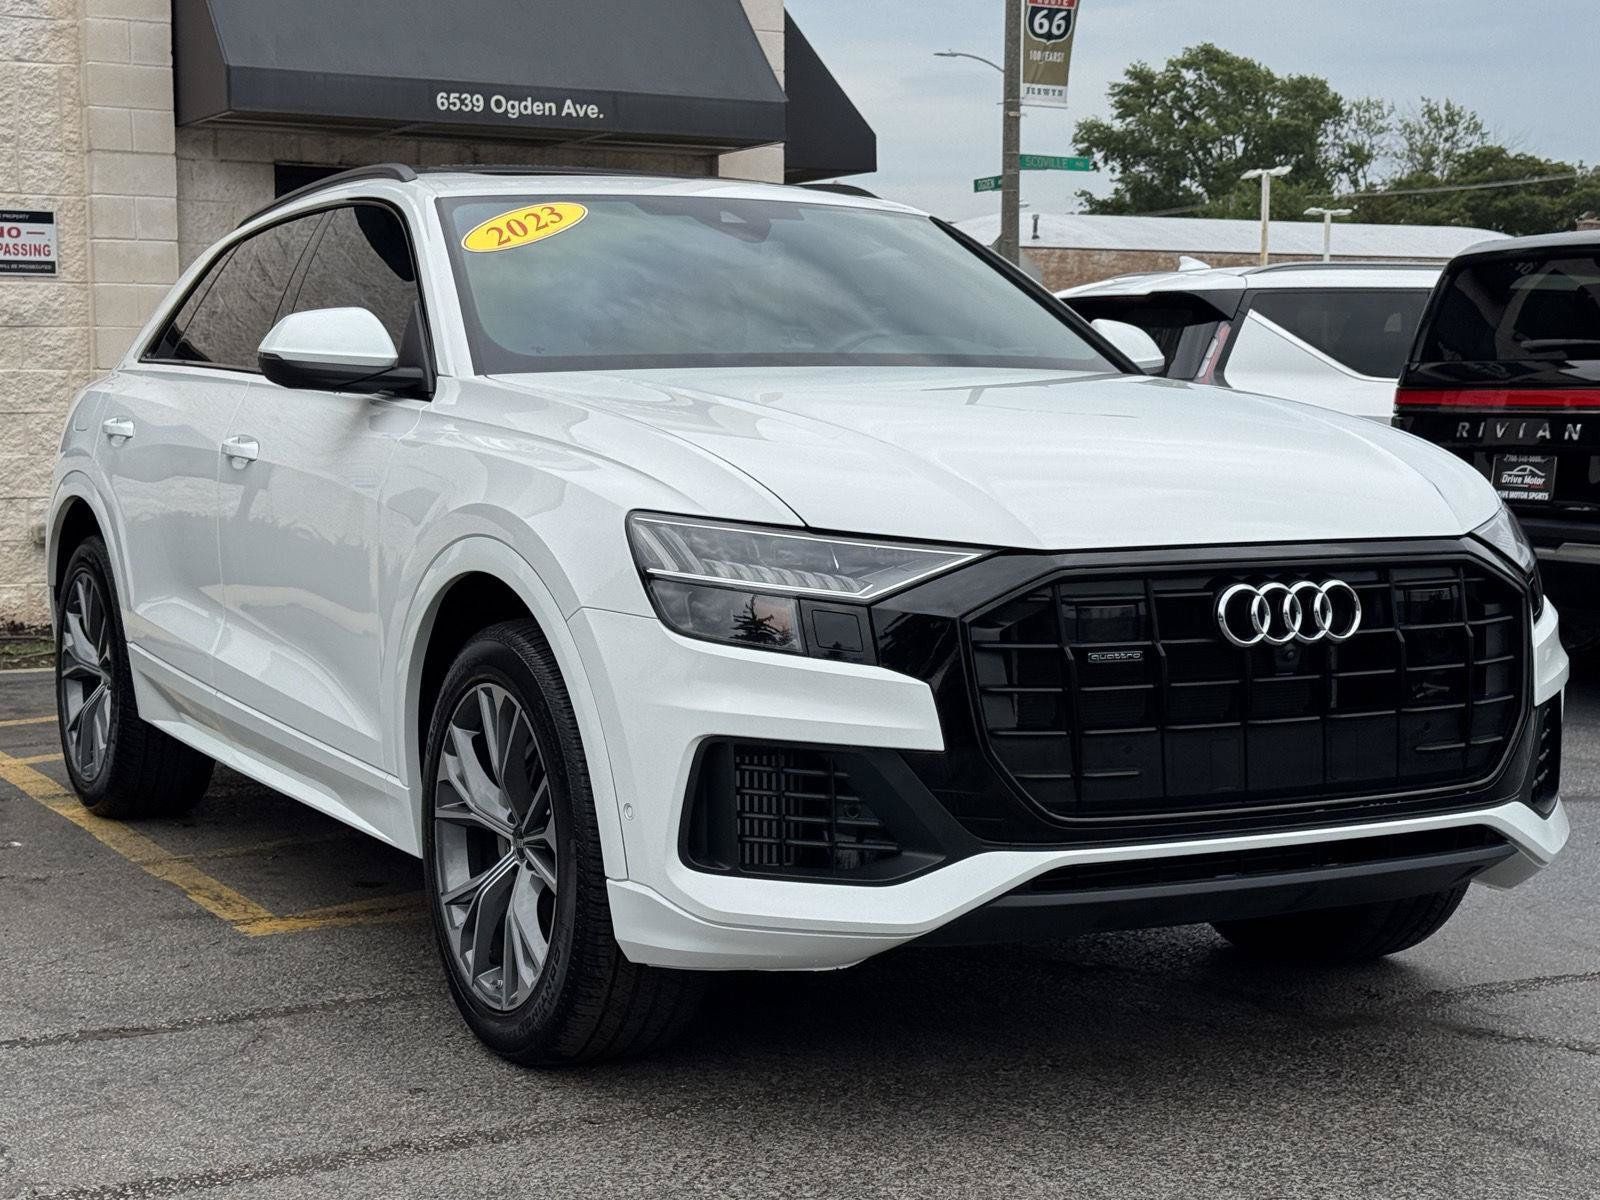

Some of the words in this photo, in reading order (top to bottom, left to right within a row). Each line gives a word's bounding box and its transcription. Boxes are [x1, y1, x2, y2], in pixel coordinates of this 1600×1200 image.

[1033, 9, 1067, 36] 66
[436, 92, 484, 112] 6539
[490, 95, 557, 119] Ogden
[561, 99, 605, 119] Ave.
[486, 206, 563, 246] 2023
[1456, 422, 1582, 440] RIVIAN
[1502, 474, 1522, 484] Drive
[1524, 475, 1545, 486] Motor
[1509, 491, 1528, 499] MOTOR
[1528, 491, 1549, 501] SPORTS
[1091, 653, 1141, 661] quattro
